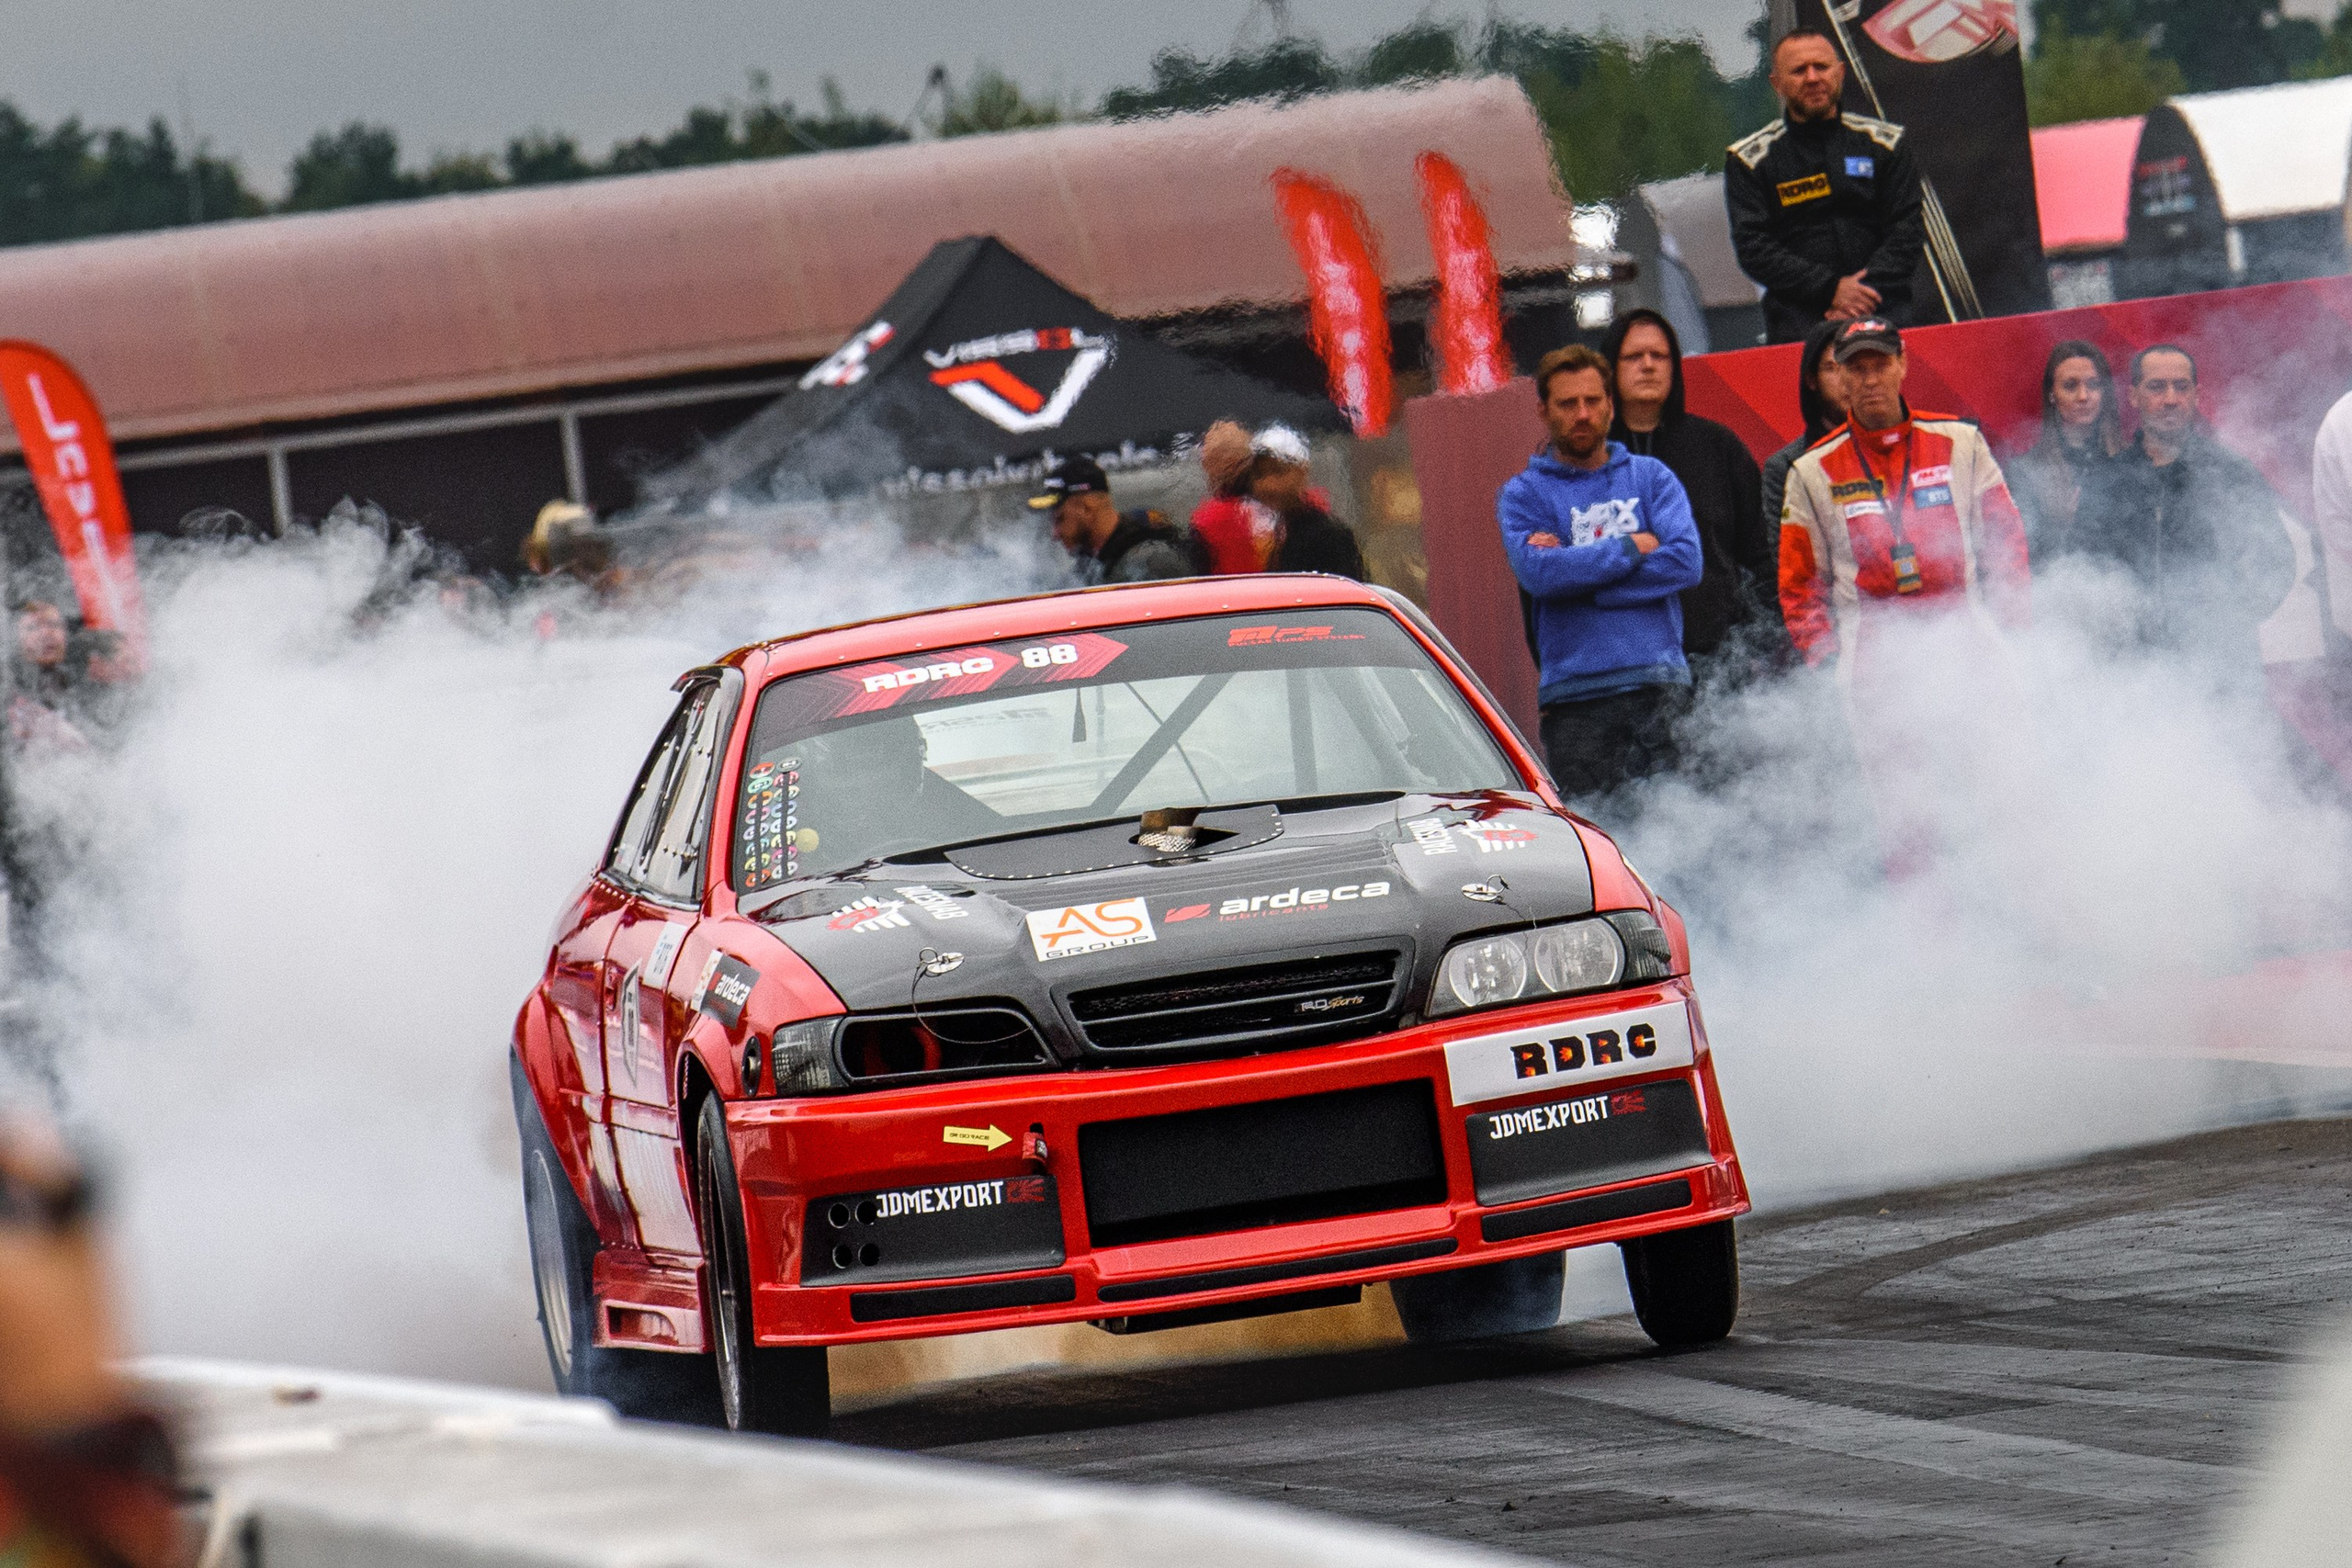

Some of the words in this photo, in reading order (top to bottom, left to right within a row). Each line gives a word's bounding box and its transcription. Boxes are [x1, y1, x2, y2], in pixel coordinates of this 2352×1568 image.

[862, 656, 994, 694] RDRC
[1021, 643, 1079, 669] 88
[1218, 903, 1329, 922] lubricants
[1219, 881, 1390, 916] ardeca
[1039, 897, 1144, 948] AS
[1046, 934, 1149, 959] GROUP
[714, 973, 752, 1006] ardeca
[1510, 1021, 1657, 1080] RDRC
[1488, 1095, 1609, 1141] JDMEXPORT
[876, 1180, 1003, 1218] JDMEXPORT
